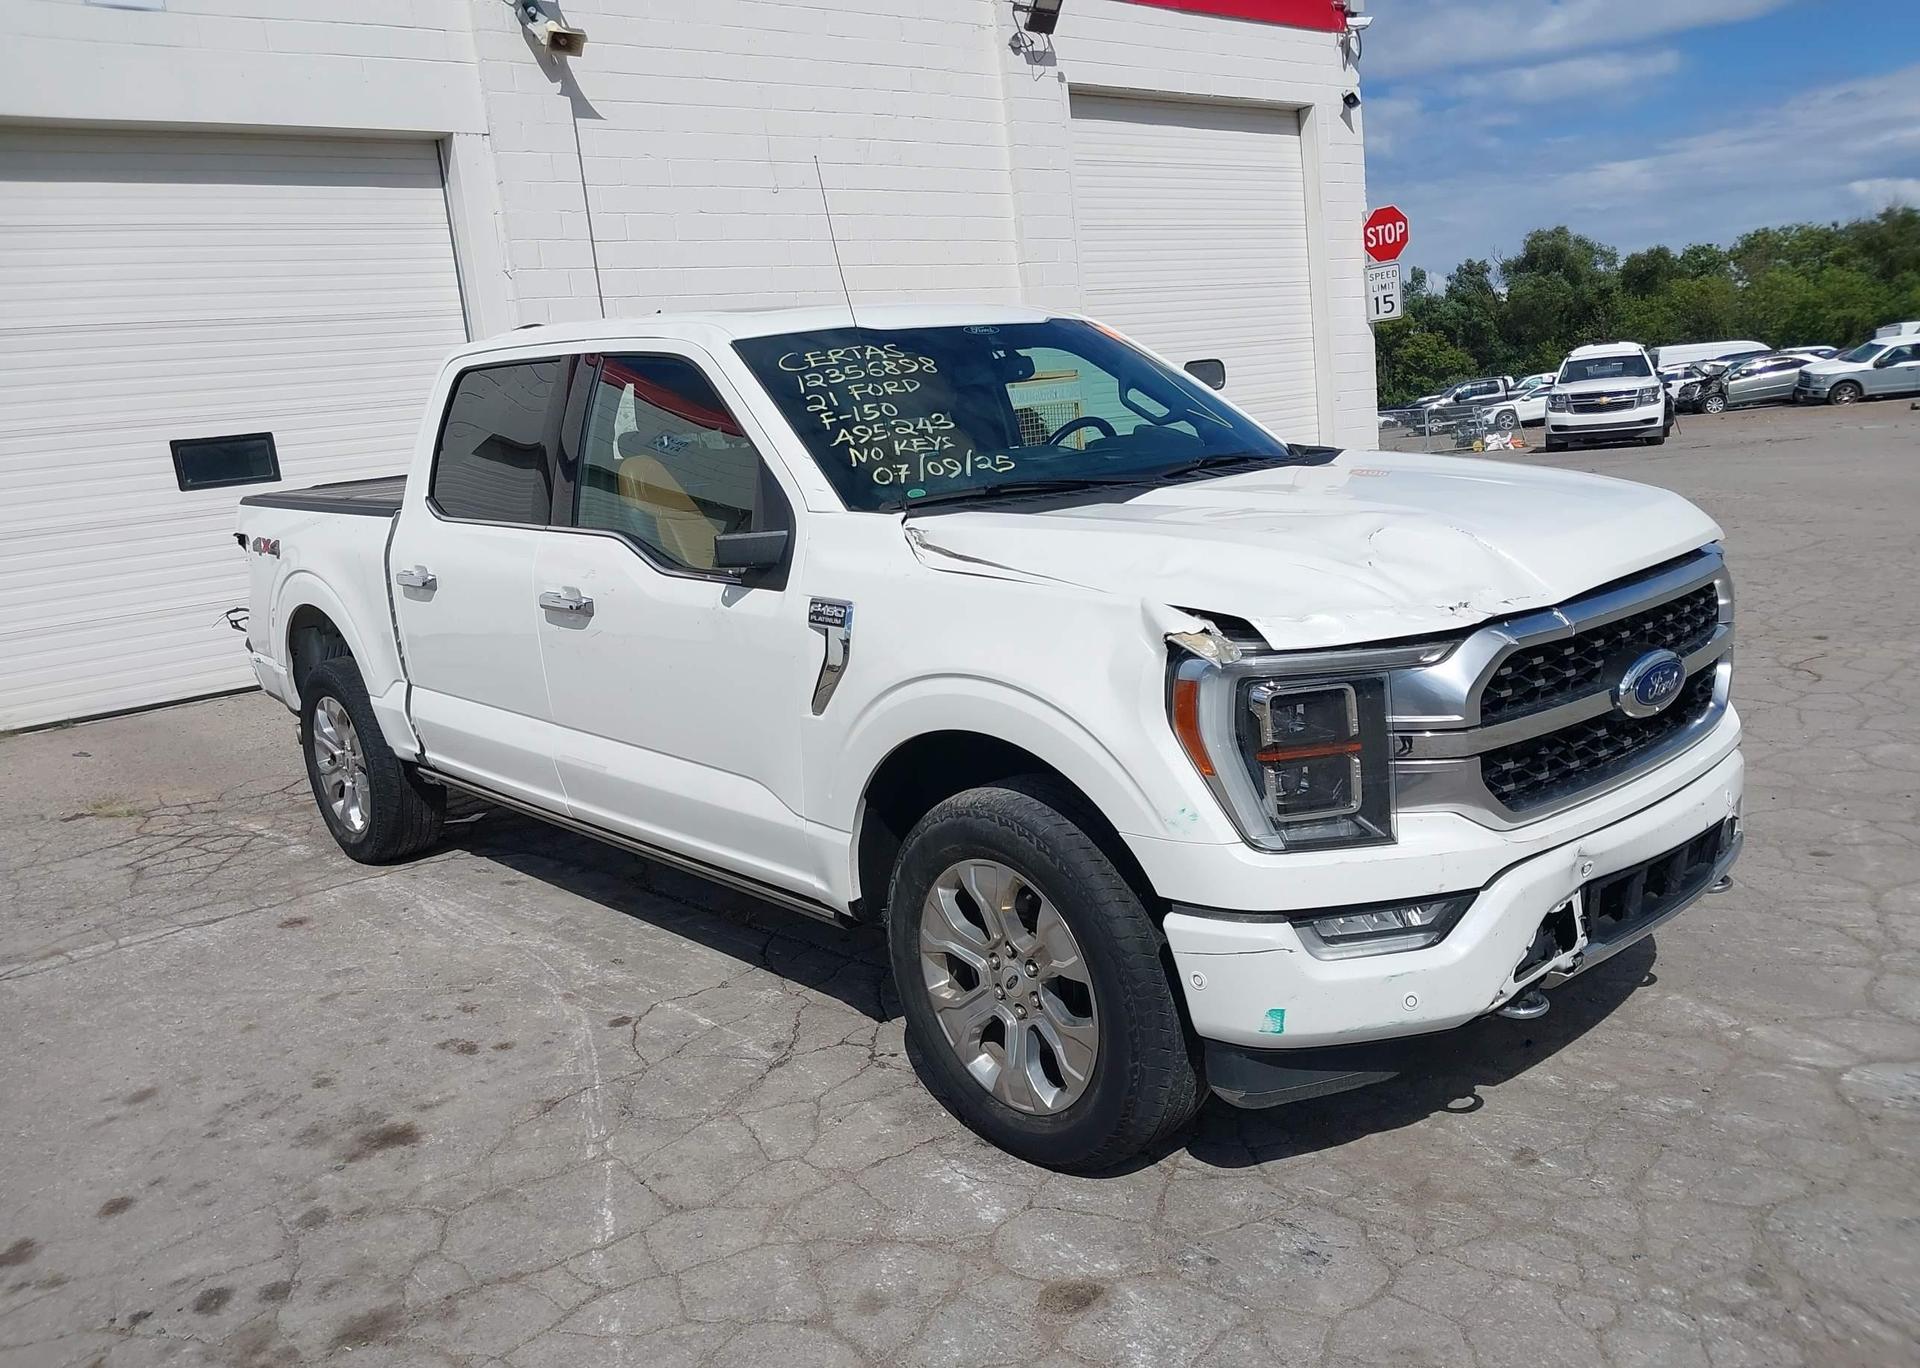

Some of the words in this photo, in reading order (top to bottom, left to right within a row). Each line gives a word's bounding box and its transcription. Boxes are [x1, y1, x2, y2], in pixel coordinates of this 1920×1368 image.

[1367, 221, 1405, 248] STOP
[1369, 269, 1398, 282] SPEED
[1372, 282, 1396, 293] LIMIT
[1374, 294, 1395, 315] 15
[778, 344, 905, 371] CERTAS
[797, 357, 938, 394] 12356898
[806, 392, 839, 412] 21
[848, 379, 921, 400] FORD
[820, 402, 898, 430] F-150
[849, 447, 884, 467] NO
[894, 436, 956, 455] KEYS
[872, 449, 1016, 485] 07/09/25
[809, 603, 845, 617] F-150
[810, 615, 842, 625] PLATINUM
[1648, 668, 1679, 700] Ford
